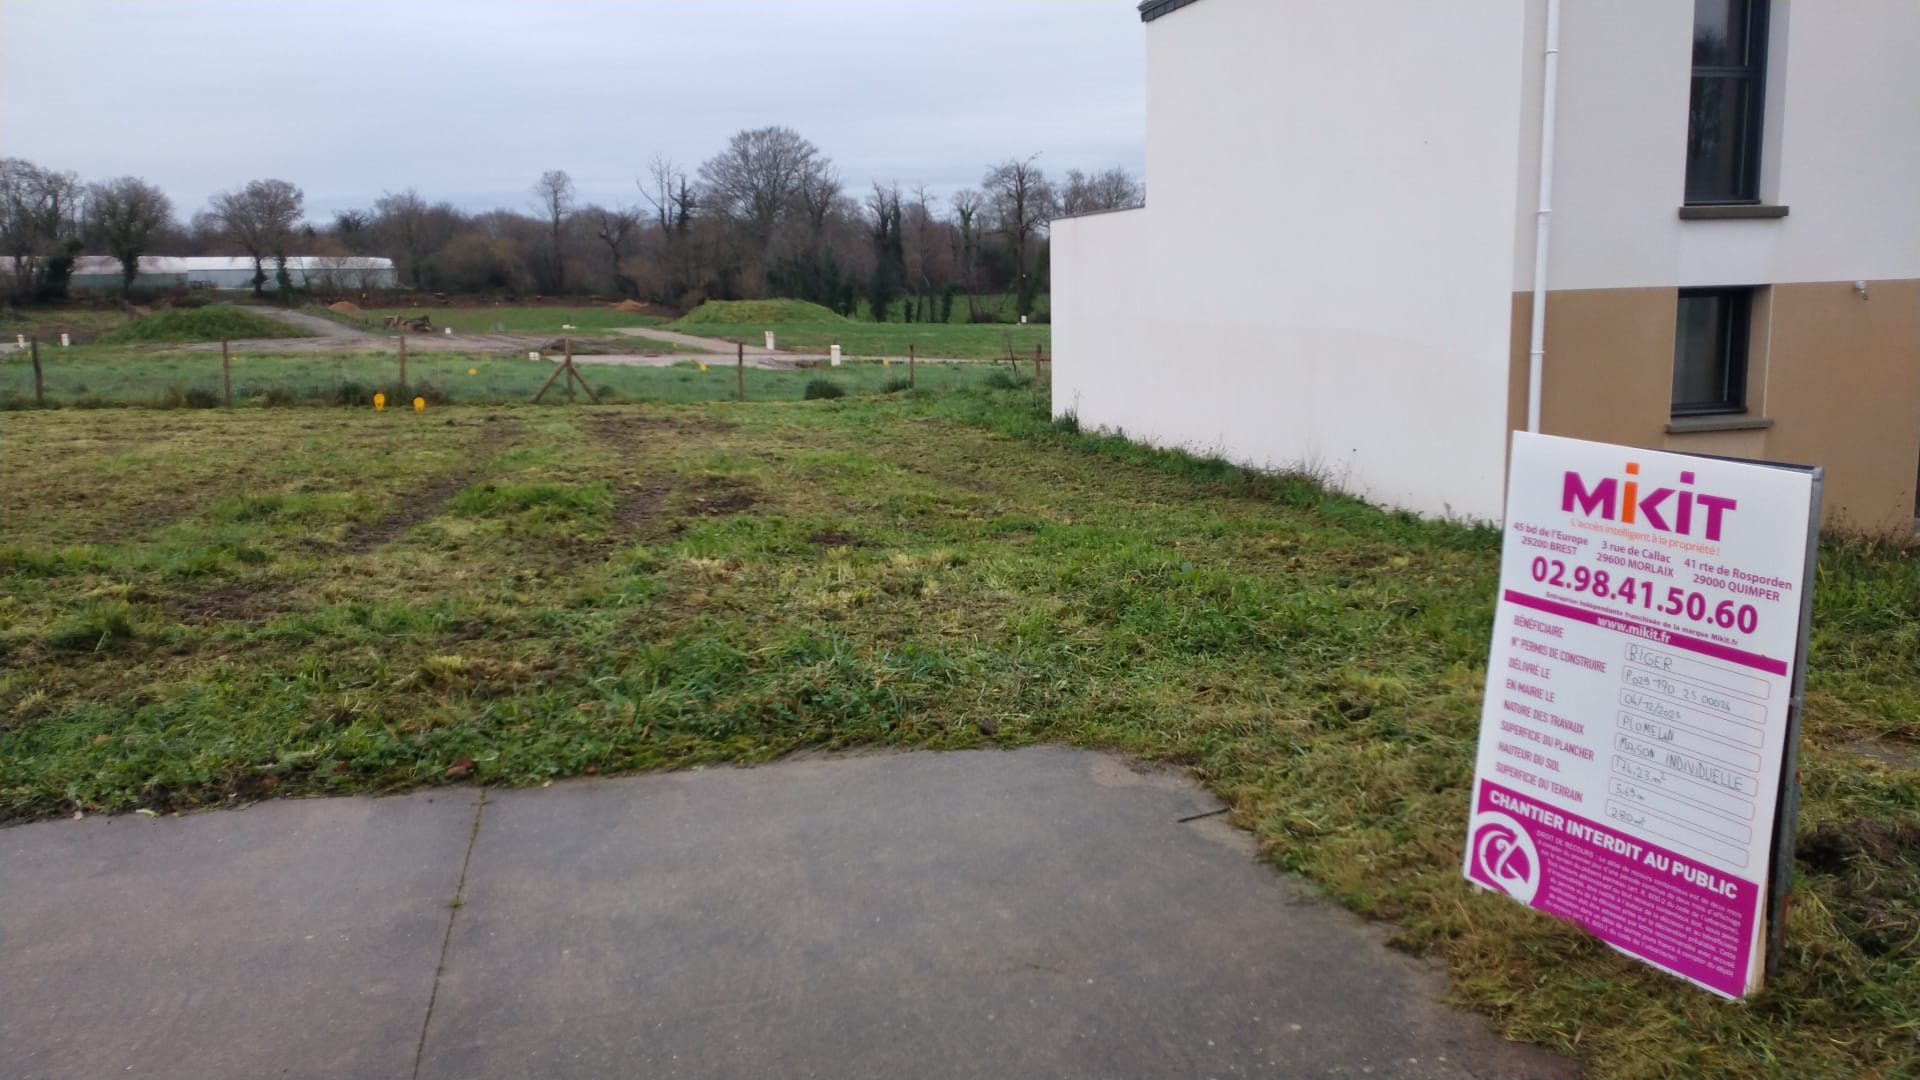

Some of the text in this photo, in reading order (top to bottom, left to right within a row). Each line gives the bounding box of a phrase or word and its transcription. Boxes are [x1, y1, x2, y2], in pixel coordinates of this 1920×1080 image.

[1521, 535, 1577, 555] 29200 BREST
[1526, 524, 1537, 534] bd
[1539, 526, 1549, 536] de
[1552, 529, 1589, 545] l'Europe
[1605, 525, 1650, 543] intelligent
[1659, 535, 1667, 544] la
[1596, 552, 1674, 577] 29600 MORLAIX
[1601, 540, 1671, 563] 3 rue de Callac
[1684, 558, 1792, 590] 41 rte de Rosporden
[1693, 574, 1780, 601] 29000 QUIMPER
[1532, 556, 1758, 634] 02.98.41.50.60
[1597, 617, 1671, 644] www.mikit.fr
[1711, 633, 1738, 646] Mikit.fr
[1521, 639, 1548, 656] PERMIS
[1549, 647, 1558, 659] DE
[1560, 650, 1607, 673] CONSTRUIRE
[1541, 667, 1551, 679] LE
[1506, 678, 1556, 703] EN MAIRIE LE
[1504, 699, 1584, 736] NATURE DES TRAVAUX
[1500, 720, 1594, 761] SUPERFICIE DU PLANCHER
[1498, 741, 1560, 773] HAUTEUR DU SOL
[1496, 761, 1583, 802] SUPERFICIE DU TERRAIN
[1489, 789, 1565, 831] CHANTIER
[1566, 820, 1642, 860] INTERDIT
[1643, 851, 1669, 871] AU
[1672, 861, 1738, 899] PUBLIC
